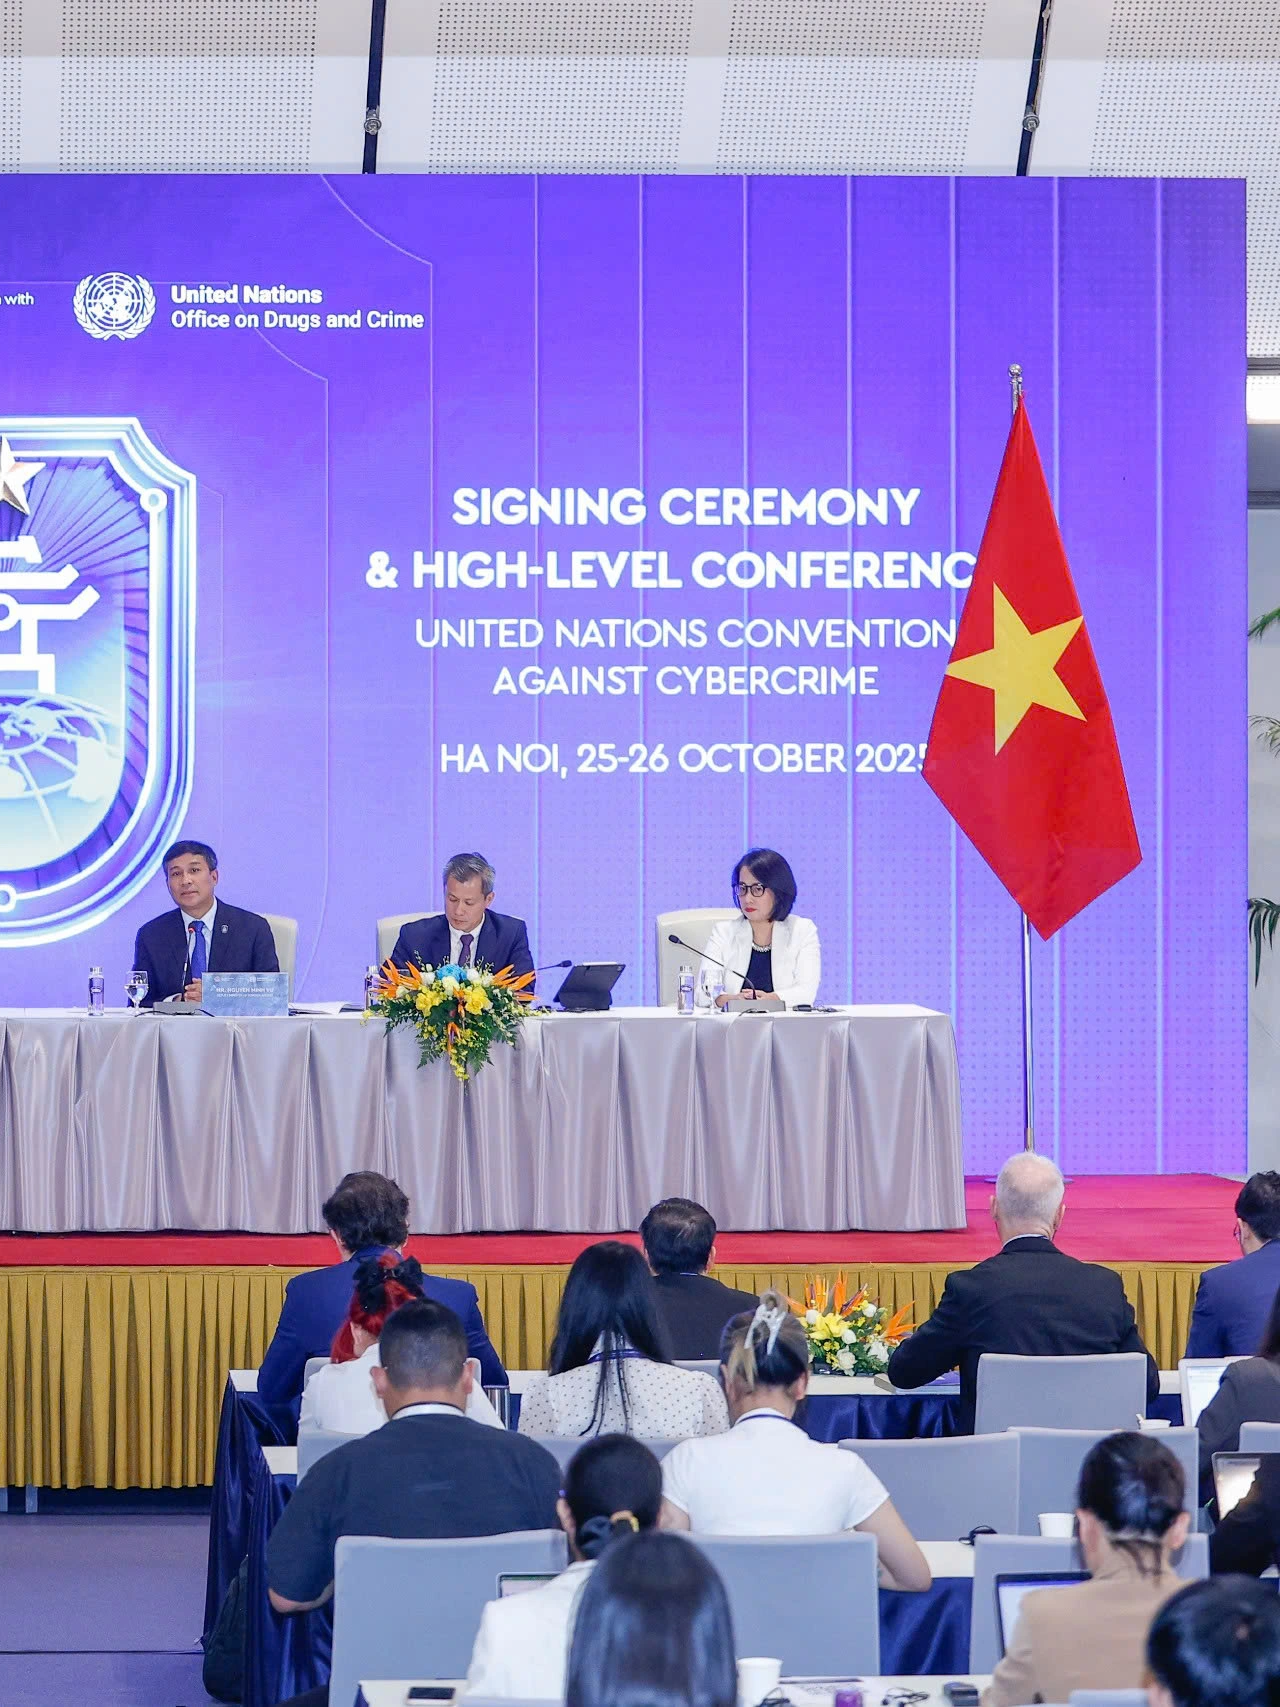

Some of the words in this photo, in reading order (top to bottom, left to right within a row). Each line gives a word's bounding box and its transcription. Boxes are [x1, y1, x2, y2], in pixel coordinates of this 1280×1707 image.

[4, 292, 34, 305] with
[172, 285, 238, 303] United
[244, 285, 322, 303] Nations
[172, 310, 229, 327] Office
[235, 315, 258, 327] on
[265, 311, 320, 332] Drugs
[327, 310, 361, 327] and
[367, 311, 424, 327] Crime
[453, 488, 646, 525] SIGNING
[660, 488, 920, 525] CEREMONY
[366, 551, 398, 588] &
[414, 551, 682, 588] HIGH-LEVEL
[692, 551, 976, 588] CONFERENC
[416, 619, 543, 647] UNITED
[556, 619, 707, 647] NATIONS
[718, 619, 955, 647] CONVENTION
[493, 666, 648, 695] AGAINST
[656, 666, 879, 695] CYBERCRIME
[441, 744, 489, 772] HA
[498, 743, 567, 779] NOI,
[577, 744, 669, 772] 25-26
[679, 743, 846, 772] OCTOBER
